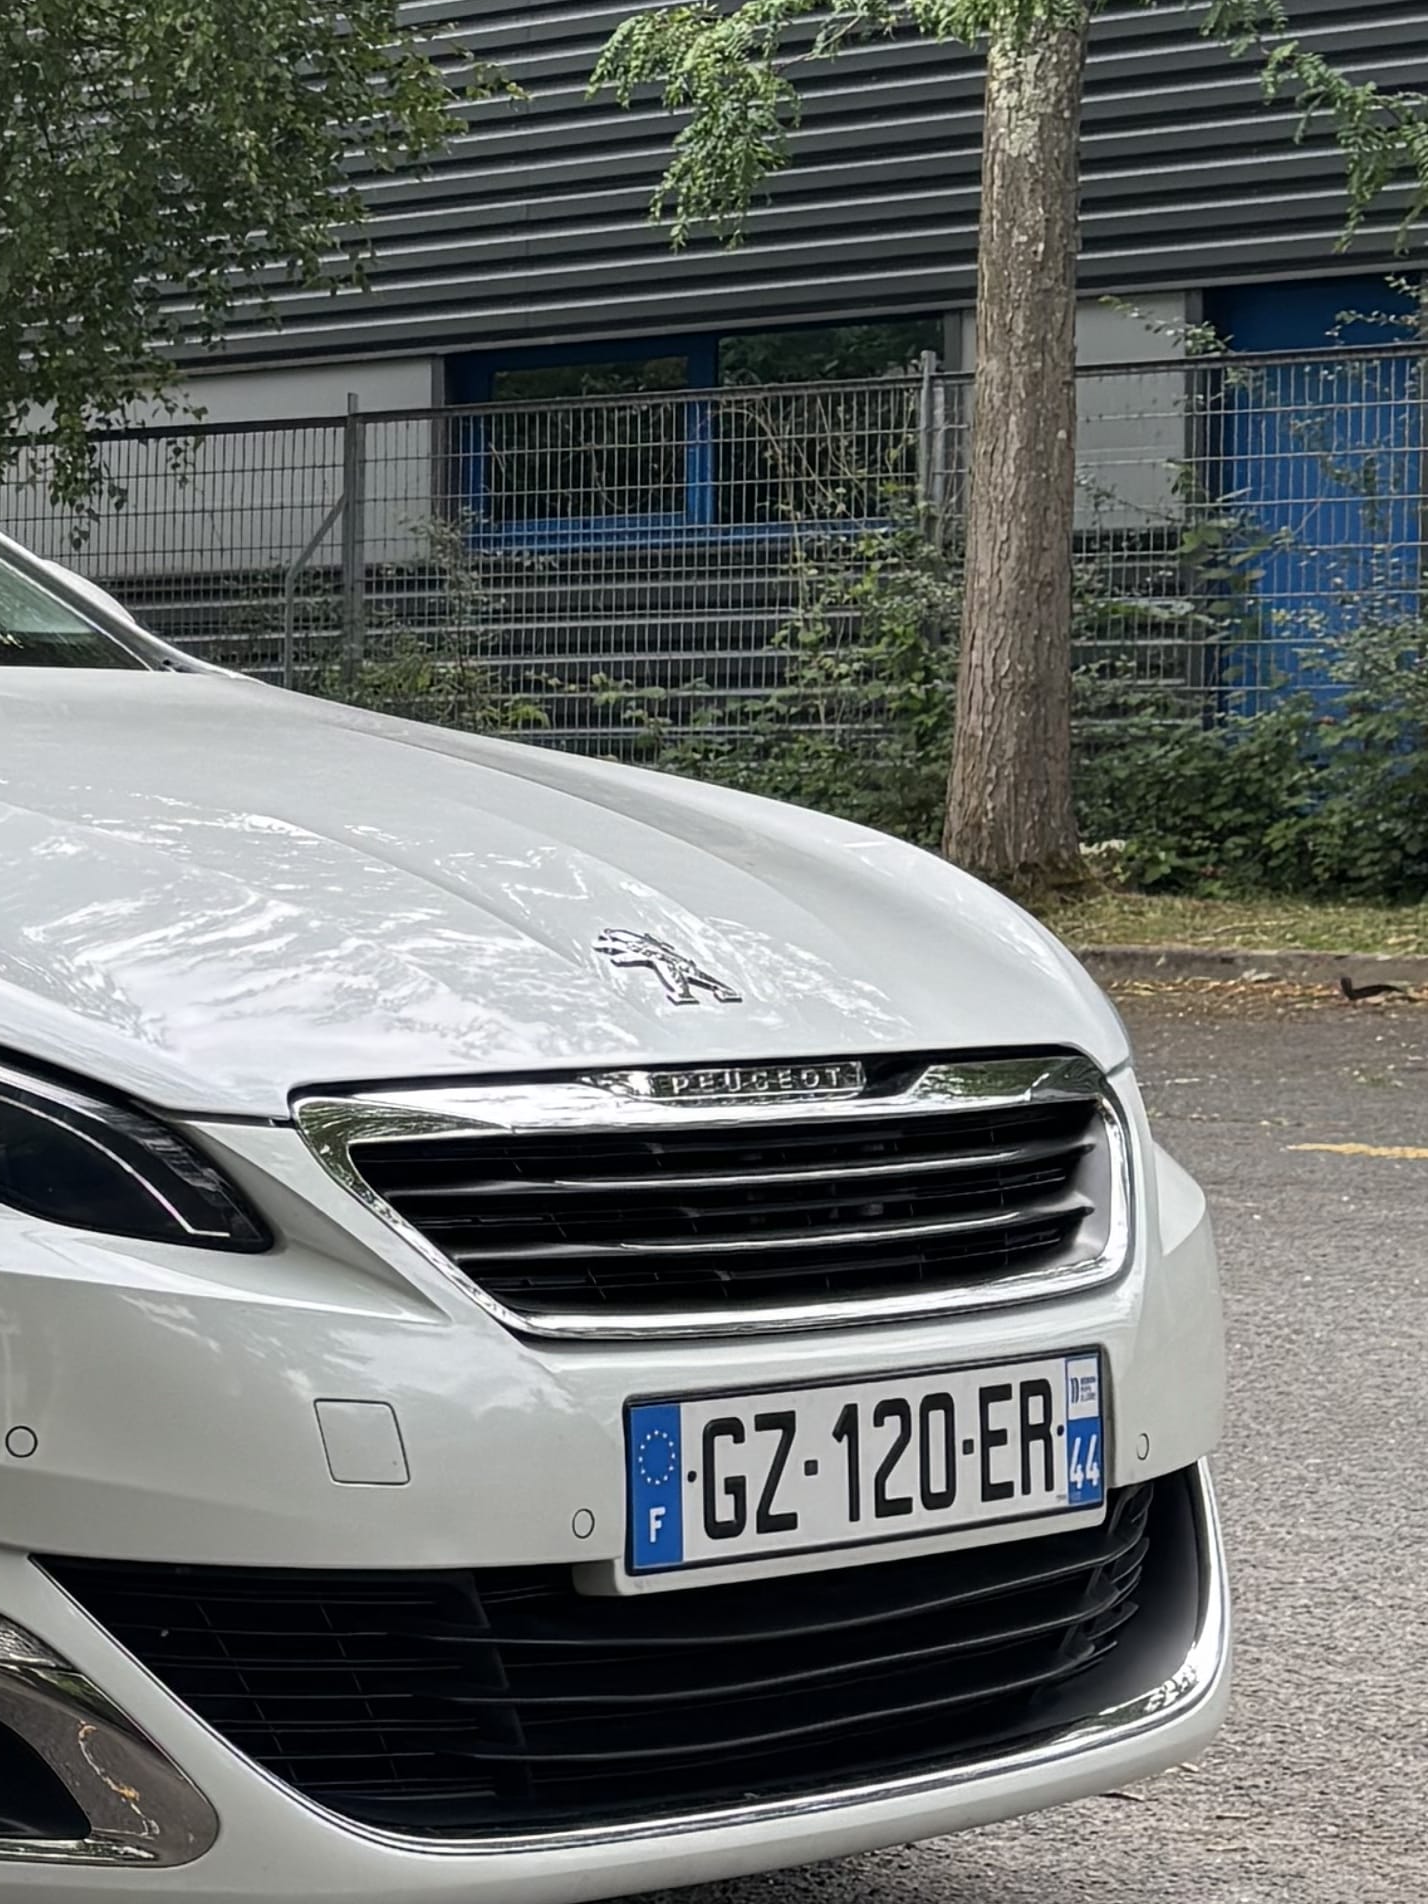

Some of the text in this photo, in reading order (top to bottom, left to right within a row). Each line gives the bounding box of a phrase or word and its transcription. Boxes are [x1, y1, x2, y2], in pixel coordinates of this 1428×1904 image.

[671, 1066, 841, 1094] PEUGEOT
[702, 1378, 1054, 1540] GZ-120-ER
[1070, 1434, 1100, 1489] 44
[649, 1506, 666, 1543] F
